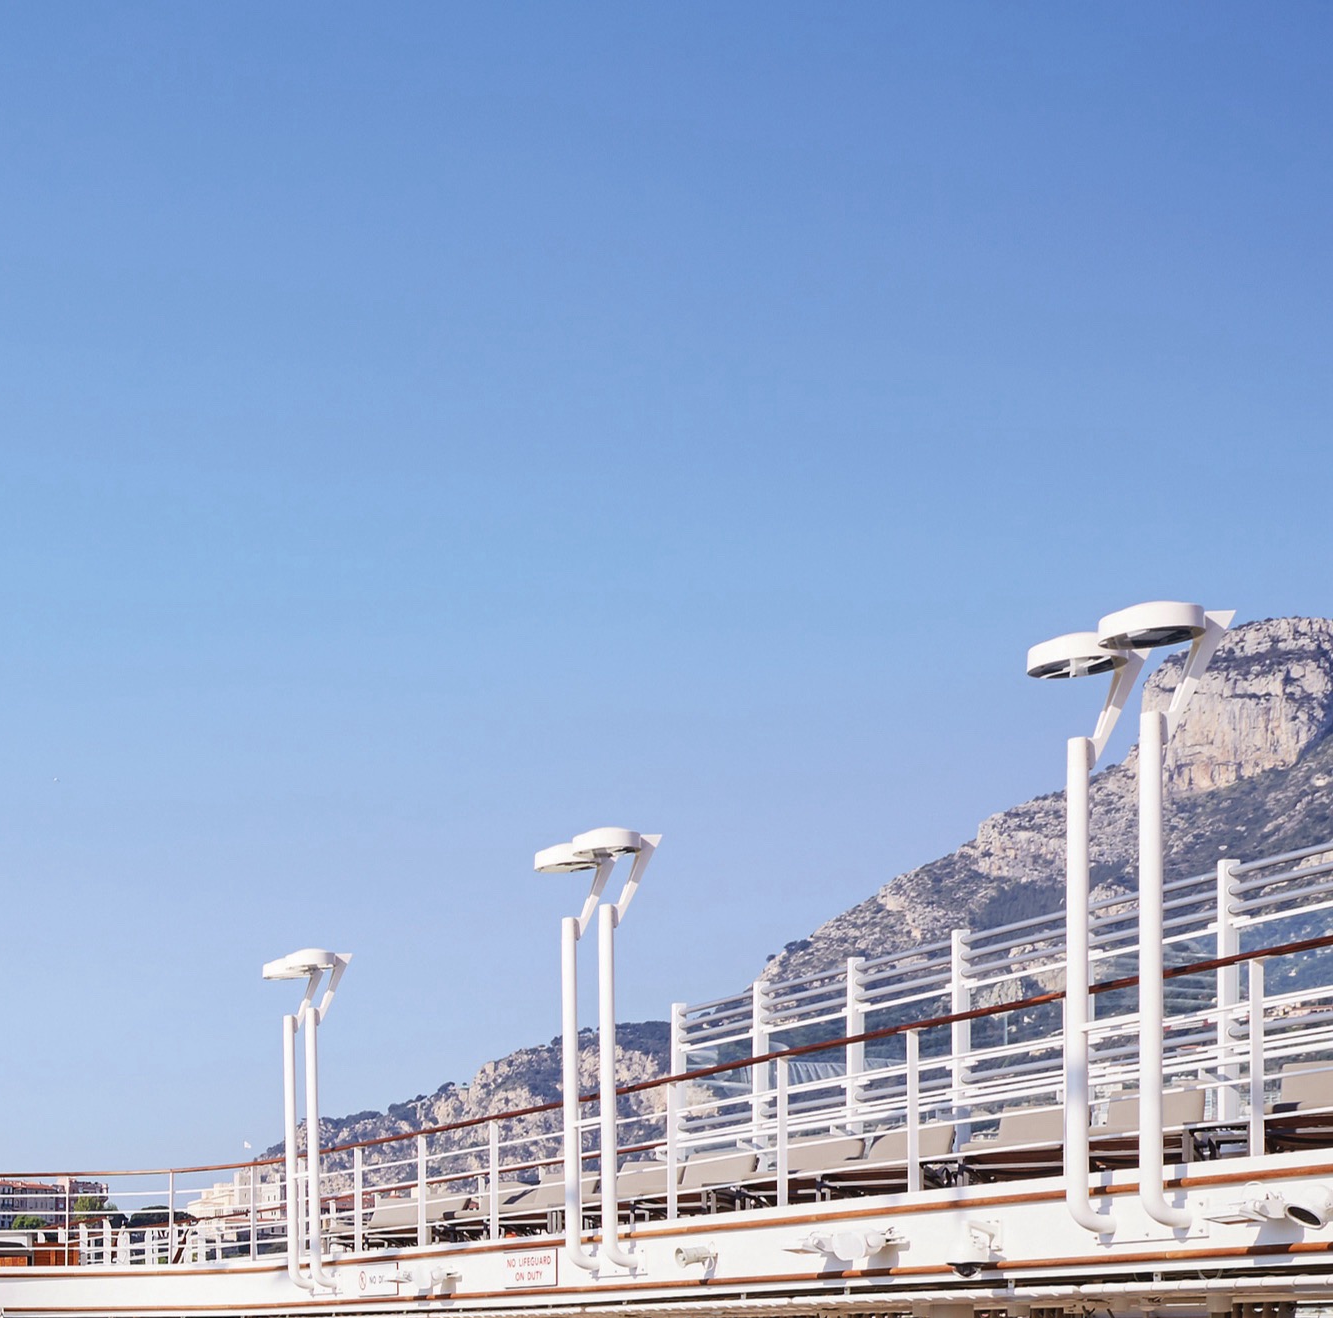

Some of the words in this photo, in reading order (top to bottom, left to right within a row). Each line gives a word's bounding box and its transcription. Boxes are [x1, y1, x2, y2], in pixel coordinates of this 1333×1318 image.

[507, 1258, 516, 1267] NO
[518, 1255, 552, 1267] LIFEGUARD
[515, 1272, 524, 1281] ON
[527, 1270, 542, 1280] DUTY
